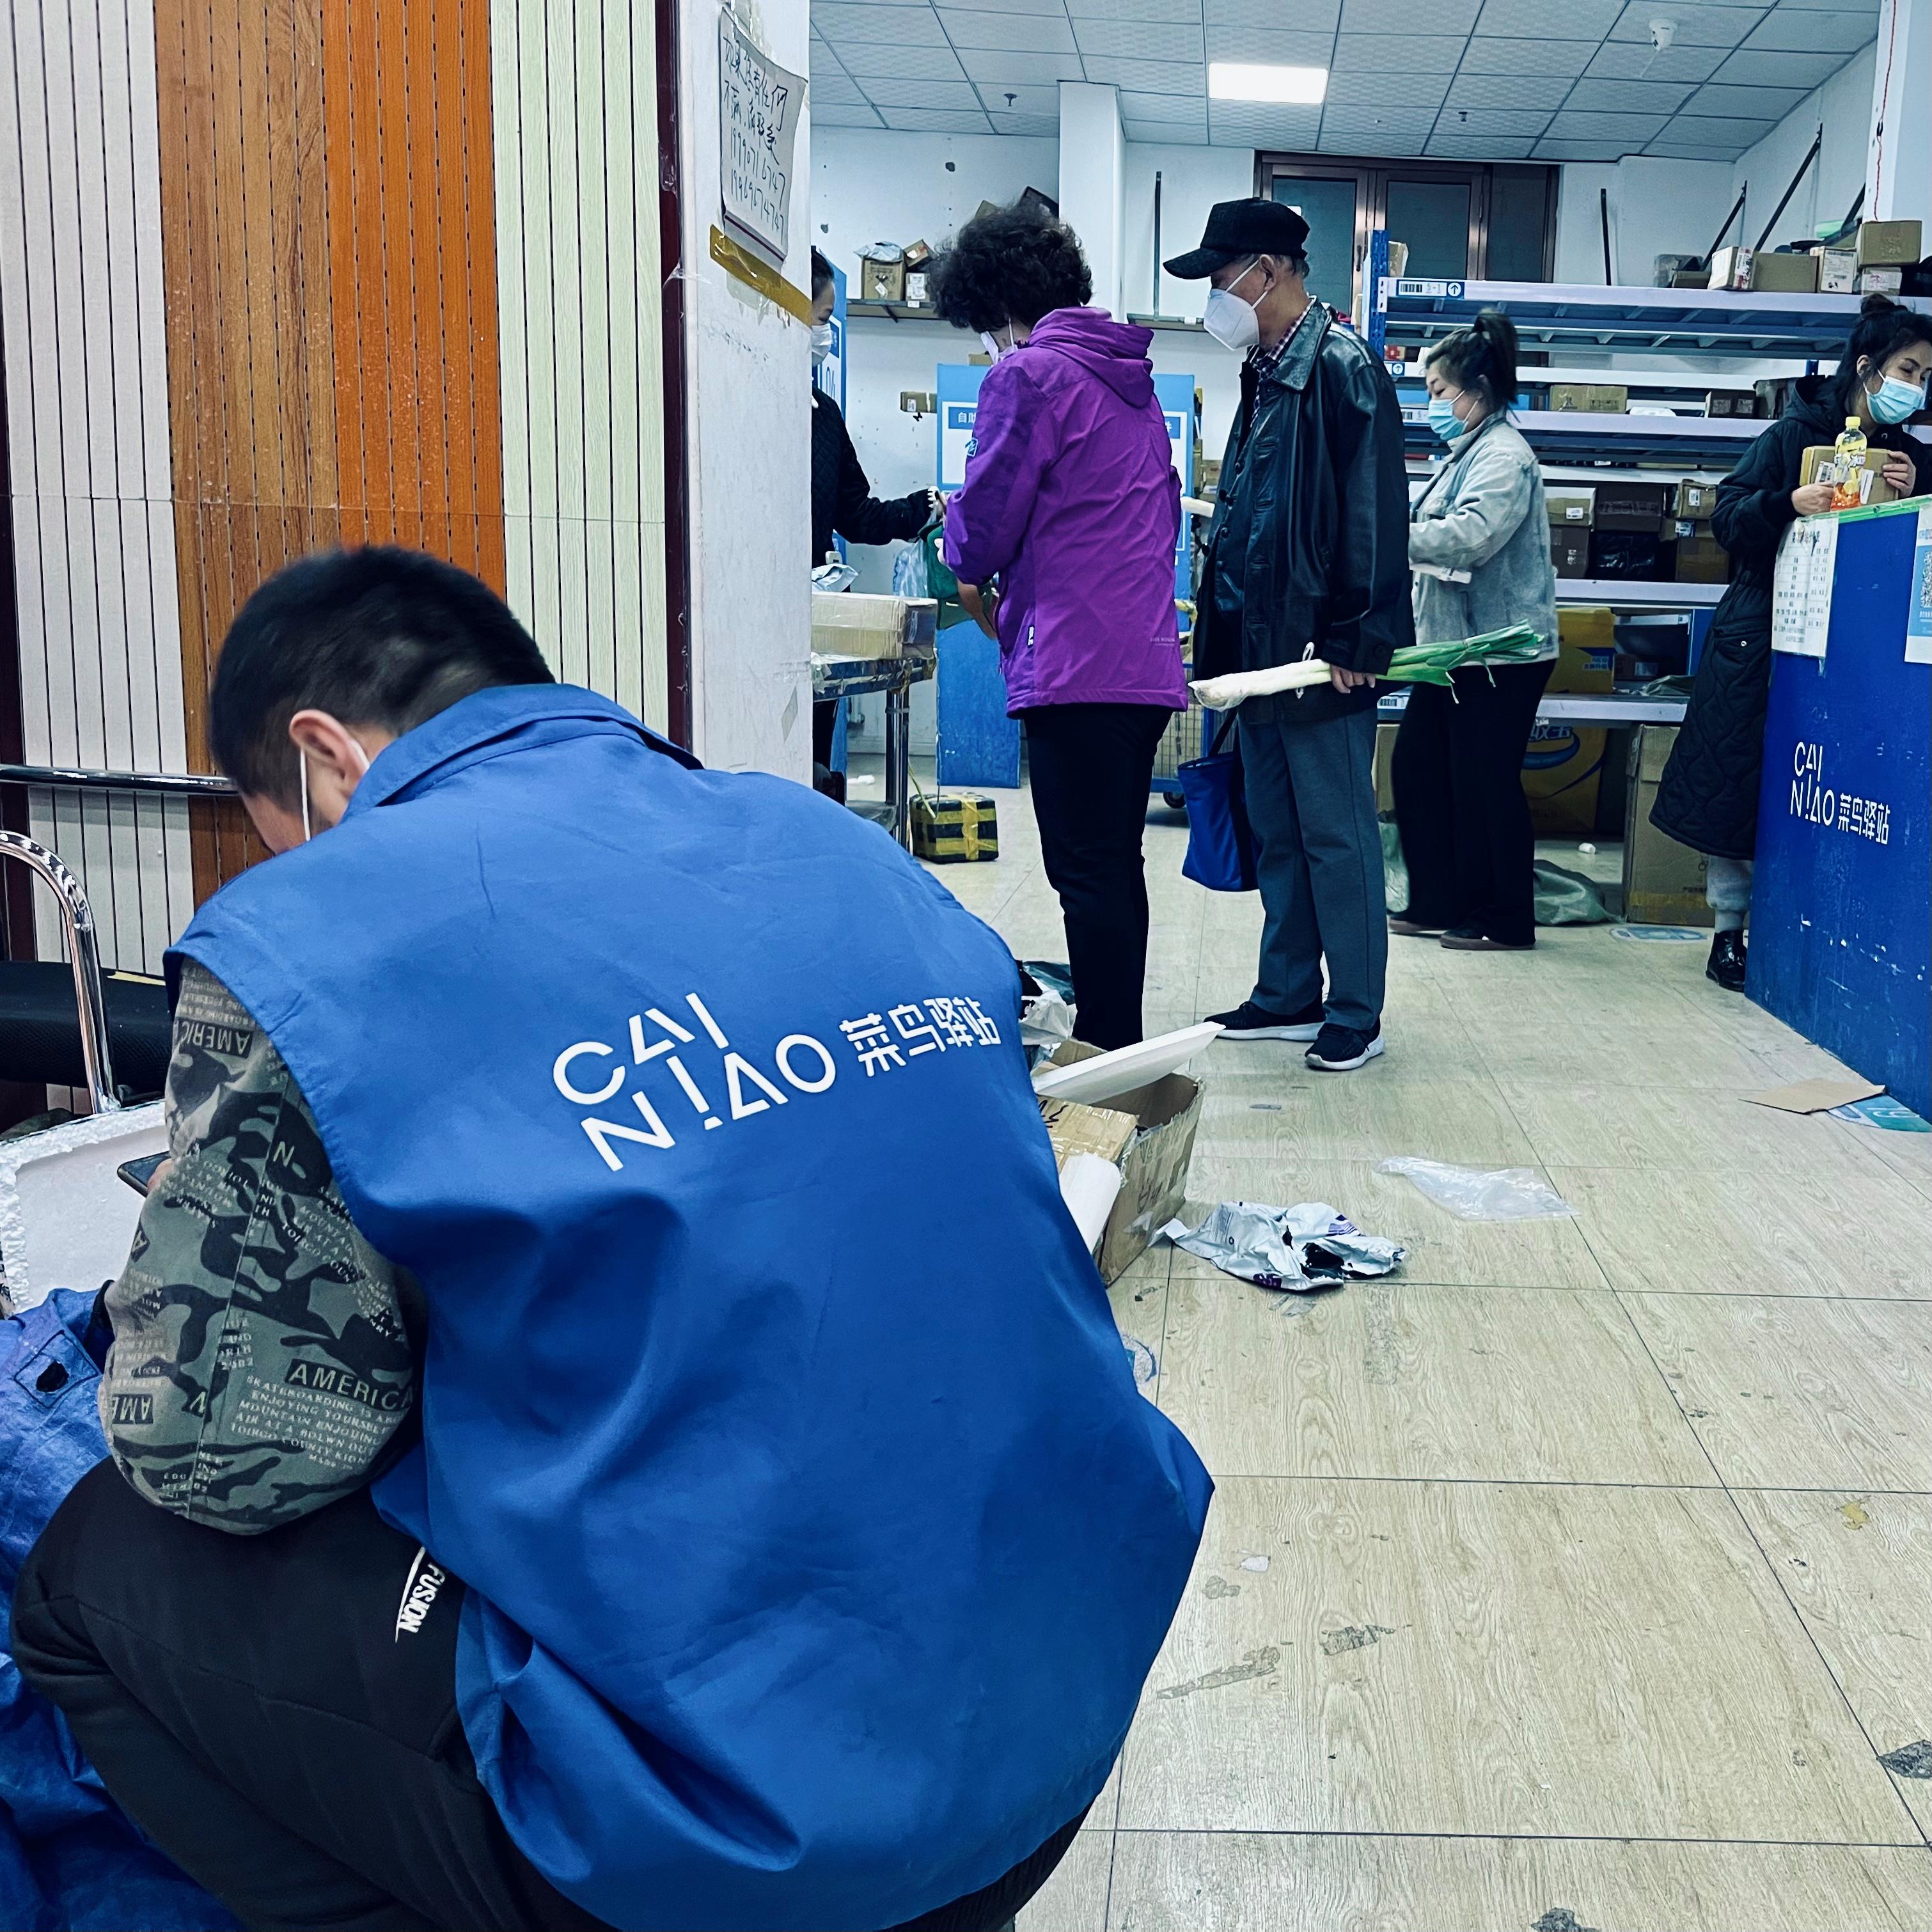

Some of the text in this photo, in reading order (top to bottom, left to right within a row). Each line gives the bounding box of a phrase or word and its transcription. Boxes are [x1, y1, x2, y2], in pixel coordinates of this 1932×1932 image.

[1795, 741, 1823, 781] CAI
[1837, 792, 1891, 845] 菜鸟驿站
[553, 992, 729, 1105] CAI
[839, 996, 1002, 1078] 菜鸟驿站
[398, 1562, 446, 1634] FUSION
